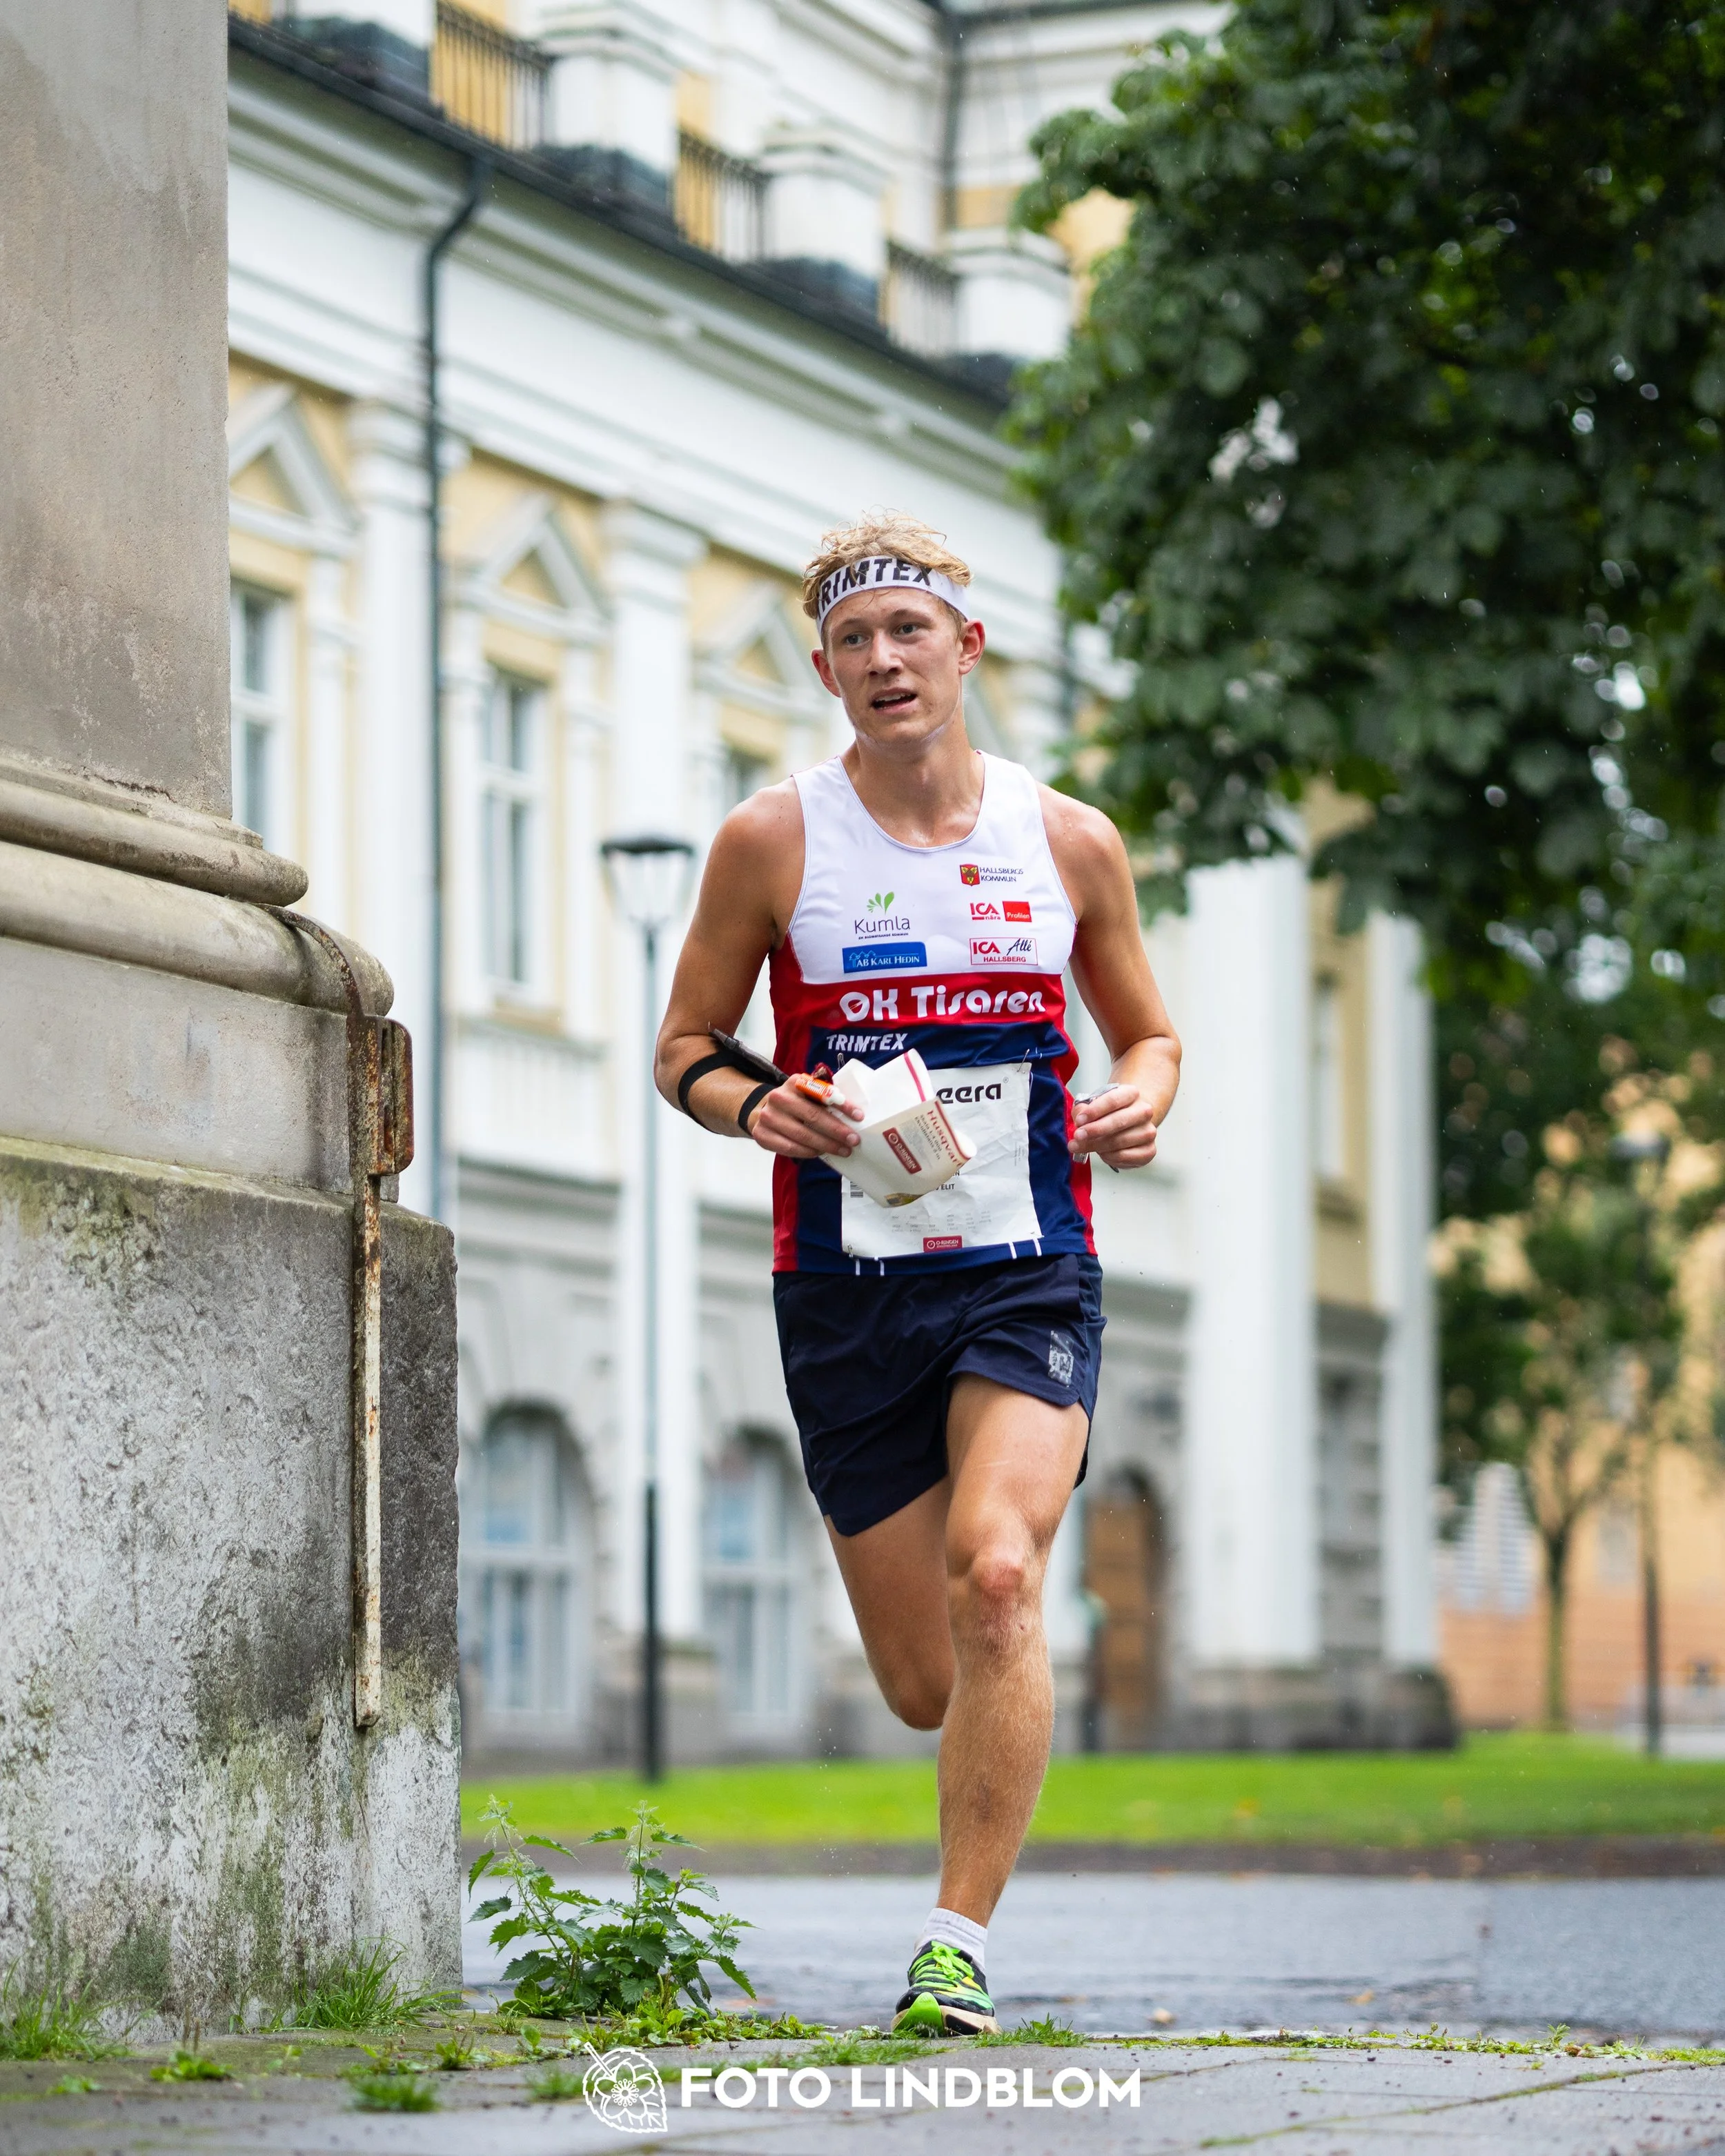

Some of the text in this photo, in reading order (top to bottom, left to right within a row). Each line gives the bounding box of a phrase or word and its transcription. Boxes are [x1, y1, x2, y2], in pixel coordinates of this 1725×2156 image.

[979, 867, 1024, 875] HALLSBERGS
[969, 902, 1000, 916] ICA
[854, 916, 910, 934] Kumla
[973, 941, 1000, 955] ICA
[857, 956, 920, 967] AB KARL HEDIN
[983, 956, 1027, 964] HALLSBERG
[839, 985, 1046, 1022] OK Tisaren
[826, 1032, 909, 1053] TRIMTEX
